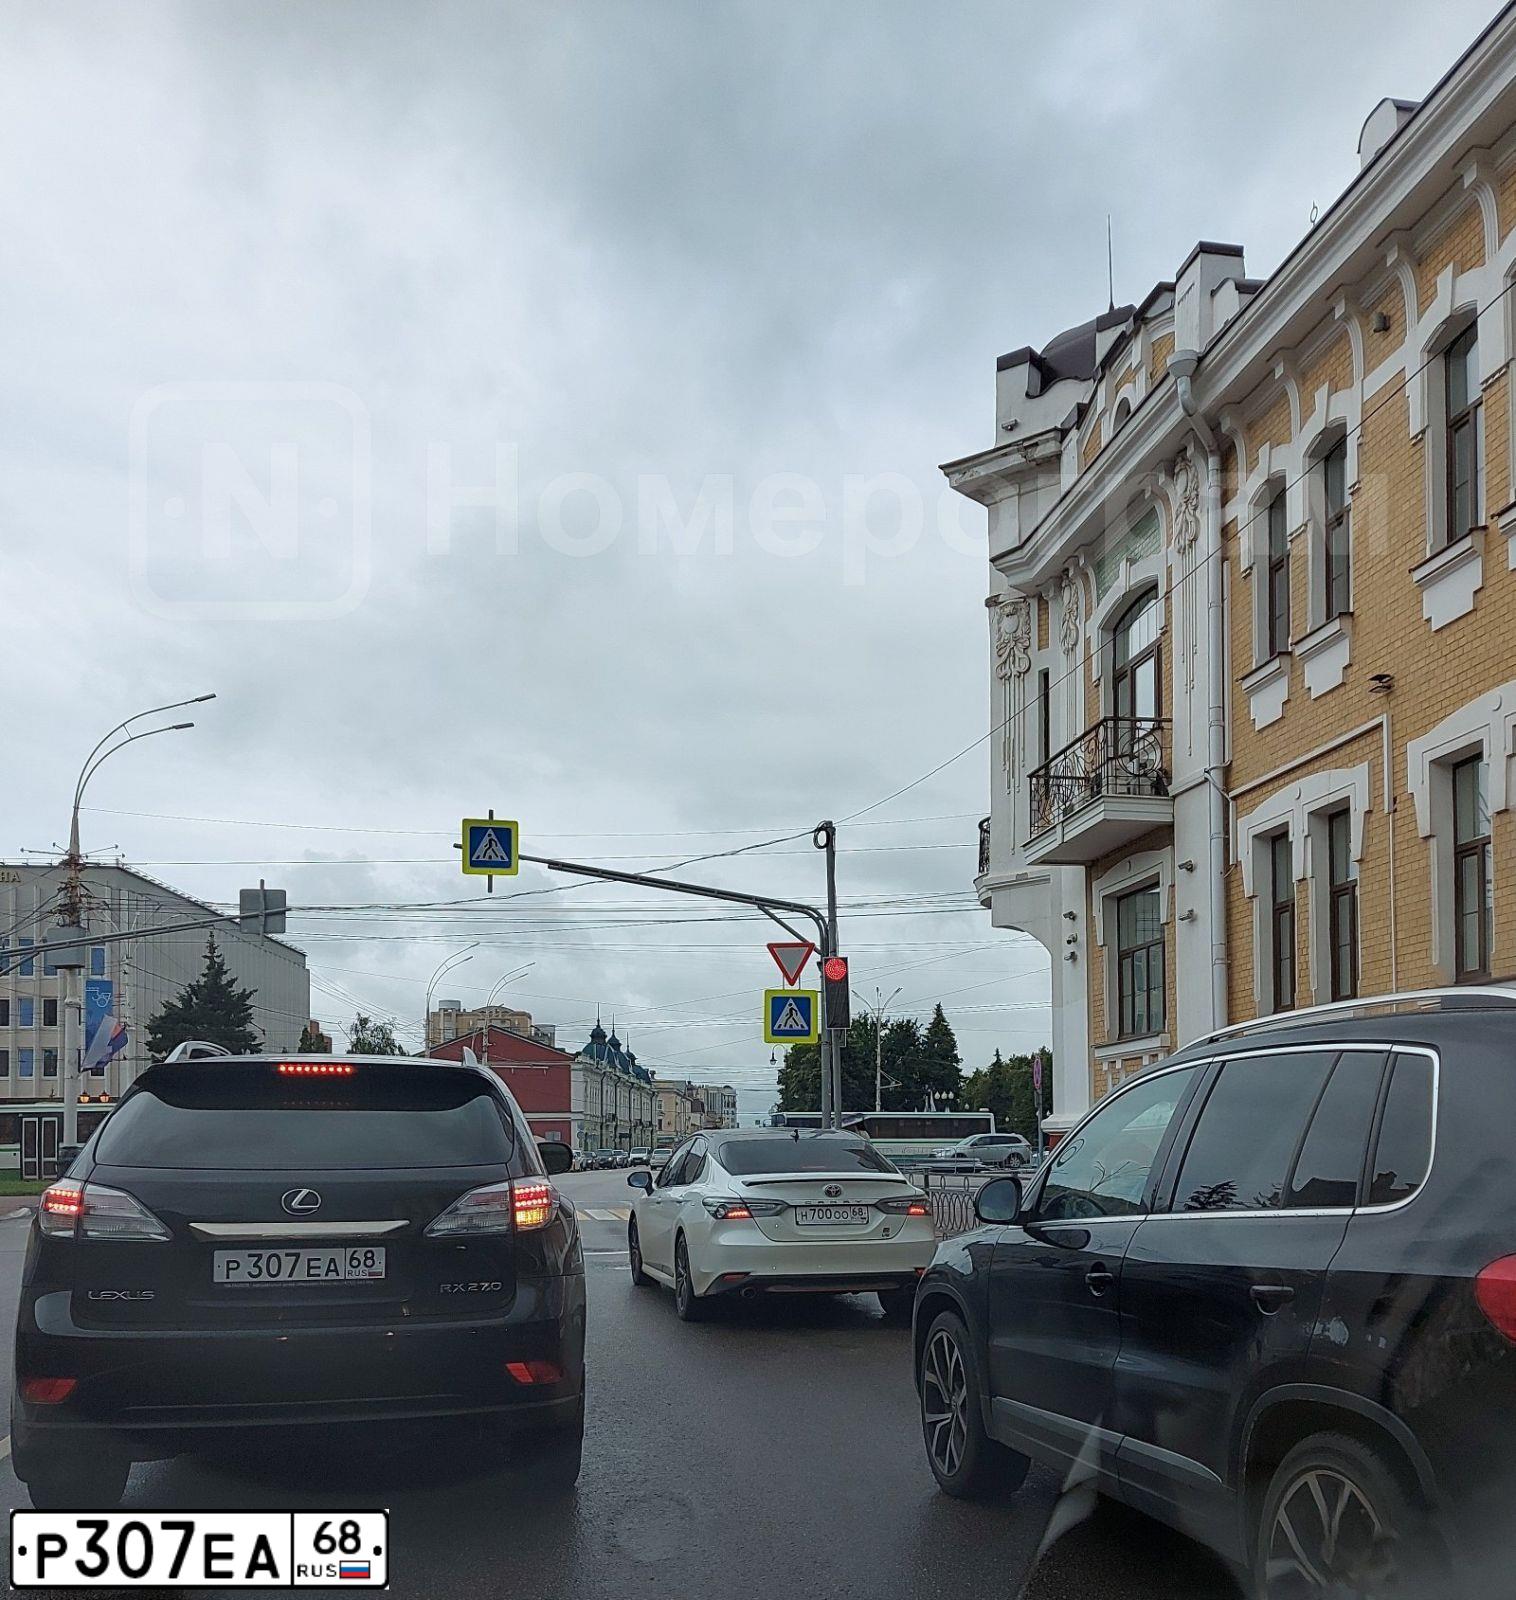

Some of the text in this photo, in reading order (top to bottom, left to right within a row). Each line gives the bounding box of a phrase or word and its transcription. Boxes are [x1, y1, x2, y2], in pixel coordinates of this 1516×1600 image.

[801, 1208, 849, 1221] Н700ОО
[852, 1207, 864, 1217] 68
[350, 1249, 375, 1269] 68
[225, 1252, 340, 1280] Р307ЕА
[347, 1269, 368, 1277] RUS
[88, 1290, 154, 1300] LEXUS
